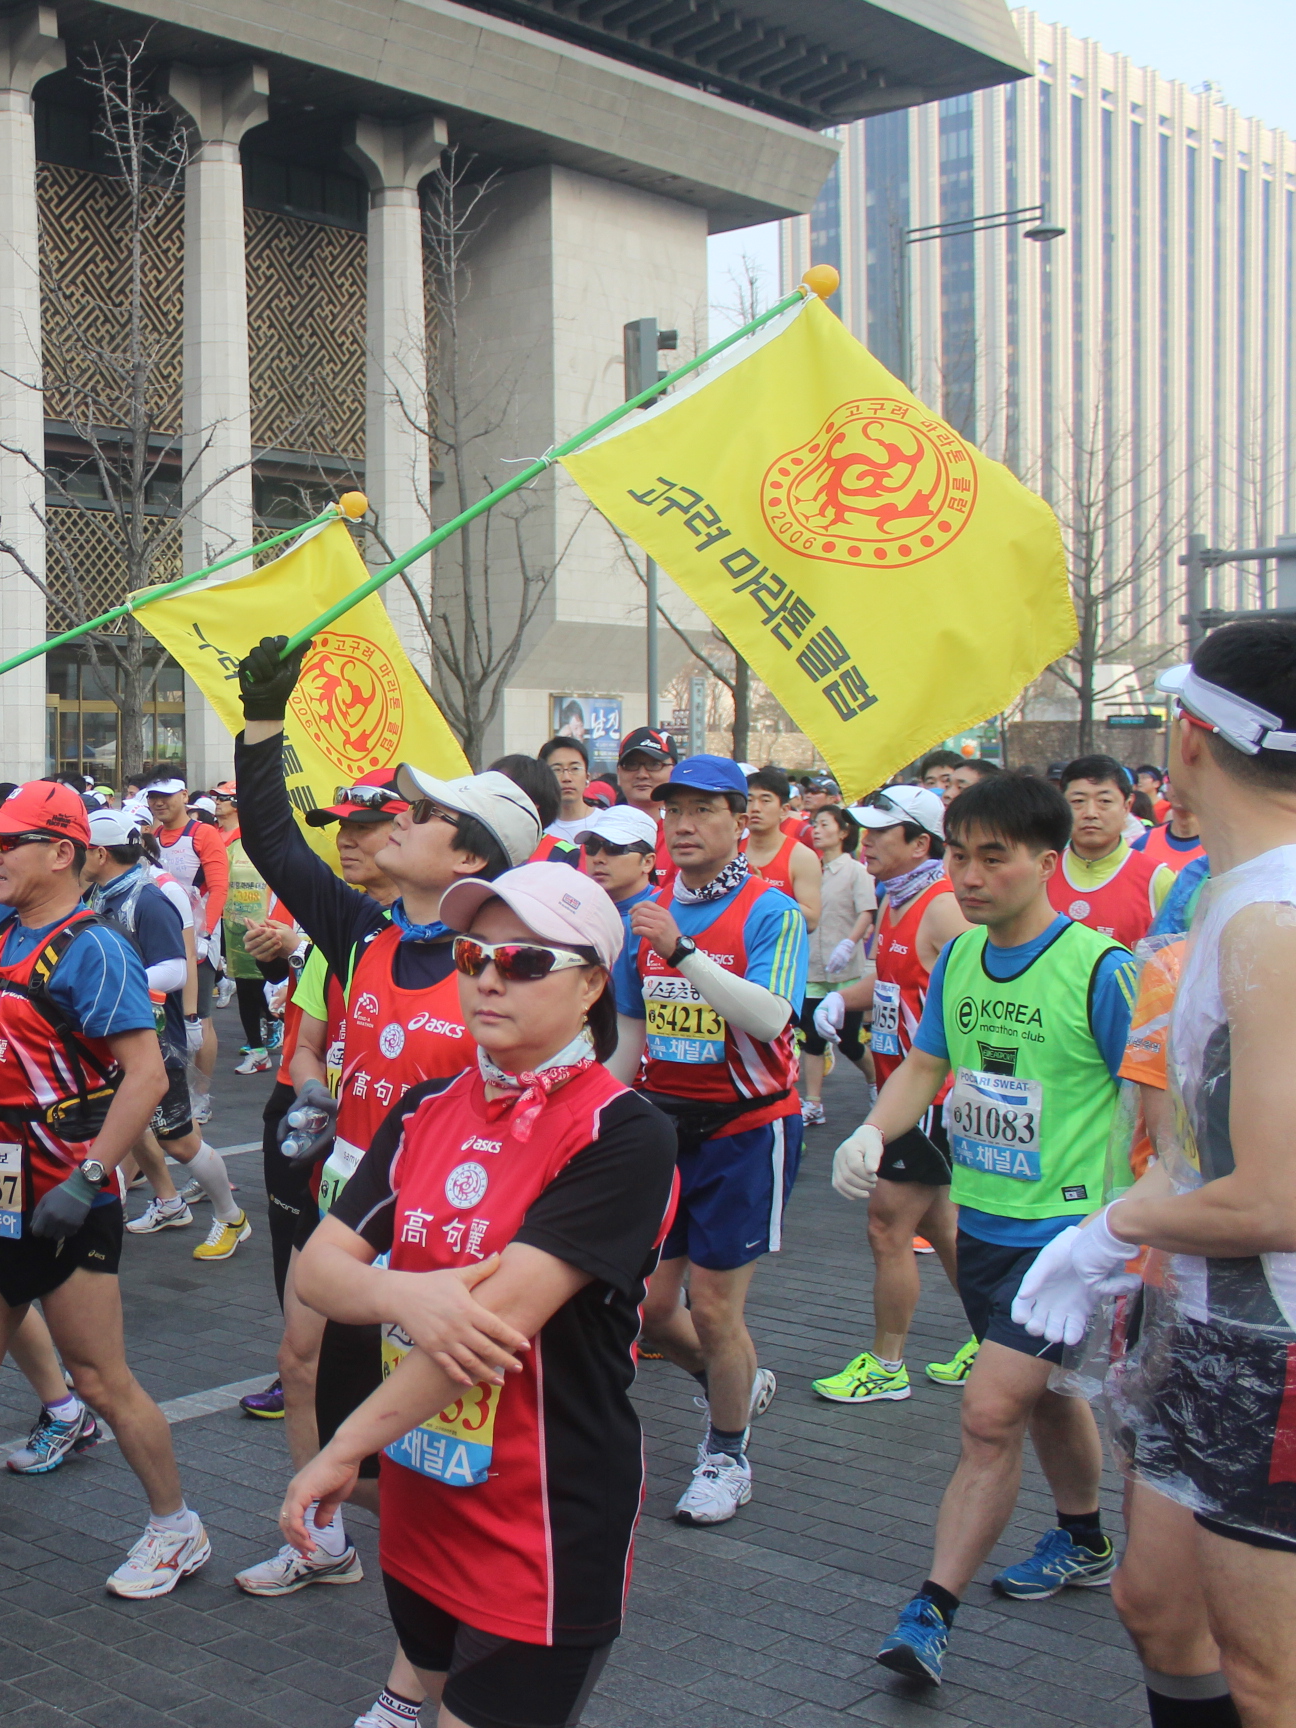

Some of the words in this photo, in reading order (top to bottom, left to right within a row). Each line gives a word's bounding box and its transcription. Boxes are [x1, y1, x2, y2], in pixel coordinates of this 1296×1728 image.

[845, 402, 910, 420] 고구려
[920, 420, 967, 465] 마라톤
[947, 477, 971, 514] 클럽
[627, 476, 732, 553] 고구려
[770, 511, 817, 550] 2006
[333, 639, 376, 662] 고구려
[378, 663, 401, 710] 마라톤
[379, 721, 400, 753] 클럽
[590, 708, 620, 740] 남진
[423, 1017, 466, 1039] asics
[655, 1003, 723, 1035] 54213
[980, 999, 1043, 1028] KOREA
[669, 1038, 719, 1062] 채널A
[1021, 1029, 1045, 1043] club
[353, 1070, 411, 1107] 高句
[960, 1071, 991, 1086] POCARI
[993, 1078, 1029, 1092] SWEAT
[961, 1101, 1035, 1144] 31083
[472, 1138, 503, 1154] asics
[975, 1145, 1032, 1177] 채널A
[400, 1207, 491, 1260] 高句麗
[400, 1429, 475, 1484] 채널A
